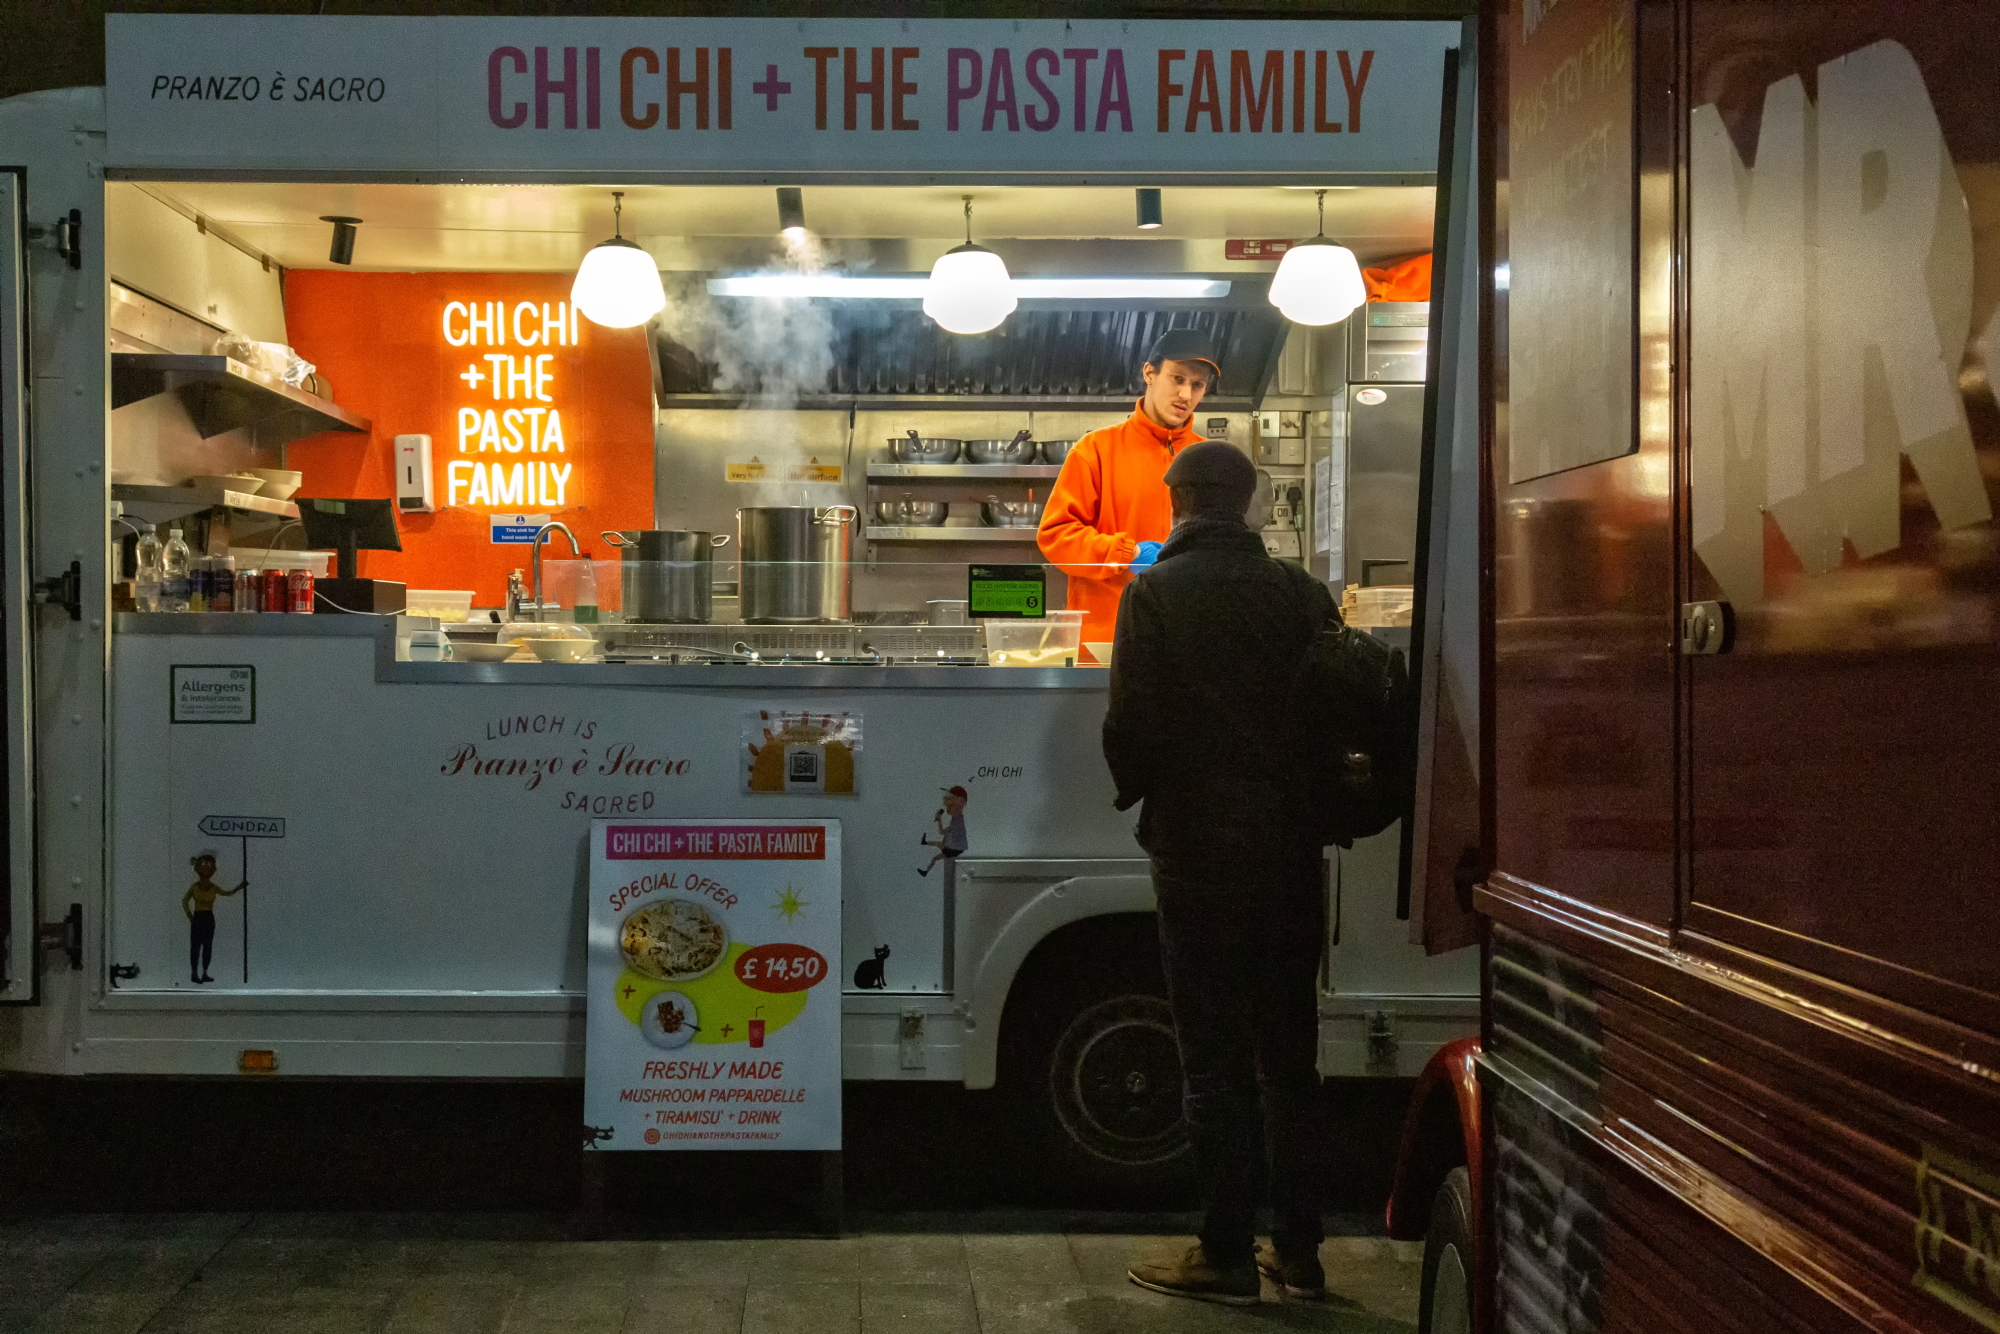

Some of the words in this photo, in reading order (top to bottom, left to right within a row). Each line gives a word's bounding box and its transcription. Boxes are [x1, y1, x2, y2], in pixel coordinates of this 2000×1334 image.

[151, 74, 260, 101] PRANZO
[292, 77, 386, 103] SACRO
[487, 45, 601, 130] CHI
[619, 46, 733, 131] CHI
[752, 64, 793, 112] +
[803, 46, 920, 131] THE
[946, 47, 1134, 132] PASTA
[1156, 48, 1375, 134] FAMILY
[442, 300, 505, 347] CHI
[512, 300, 579, 347] CHI
[458, 407, 565, 453] PASTA
[447, 460, 572, 507] FAMILY
[808, 473, 838, 481] surface
[1029, 597, 1036, 607] 5
[181, 680, 245, 694] Allergens
[487, 714, 565, 740] LUNCH
[574, 719, 597, 740] IS
[440, 742, 563, 791] Pranzo
[598, 742, 691, 776] Sacro
[978, 766, 999, 778] CHI
[1001, 766, 1023, 778] CHI
[561, 791, 655, 814] SACRED
[210, 820, 279, 833] LONDRA
[613, 833, 641, 853] CHI
[643, 833, 671, 853] CHI
[687, 833, 714, 853] THE
[718, 833, 763, 853] PASTA
[767, 833, 818, 853] FAMILY
[609, 873, 678, 912] SPECIAL
[684, 874, 739, 910] OFFER
[766, 957, 820, 981] 14.50
[642, 1061, 726, 1080] FRESHLY
[727, 1061, 784, 1079] MADE
[619, 1089, 706, 1103] MUSHROOM
[708, 1089, 806, 1103] PAPPARDELLE
[737, 1110, 782, 1125] DRINK
